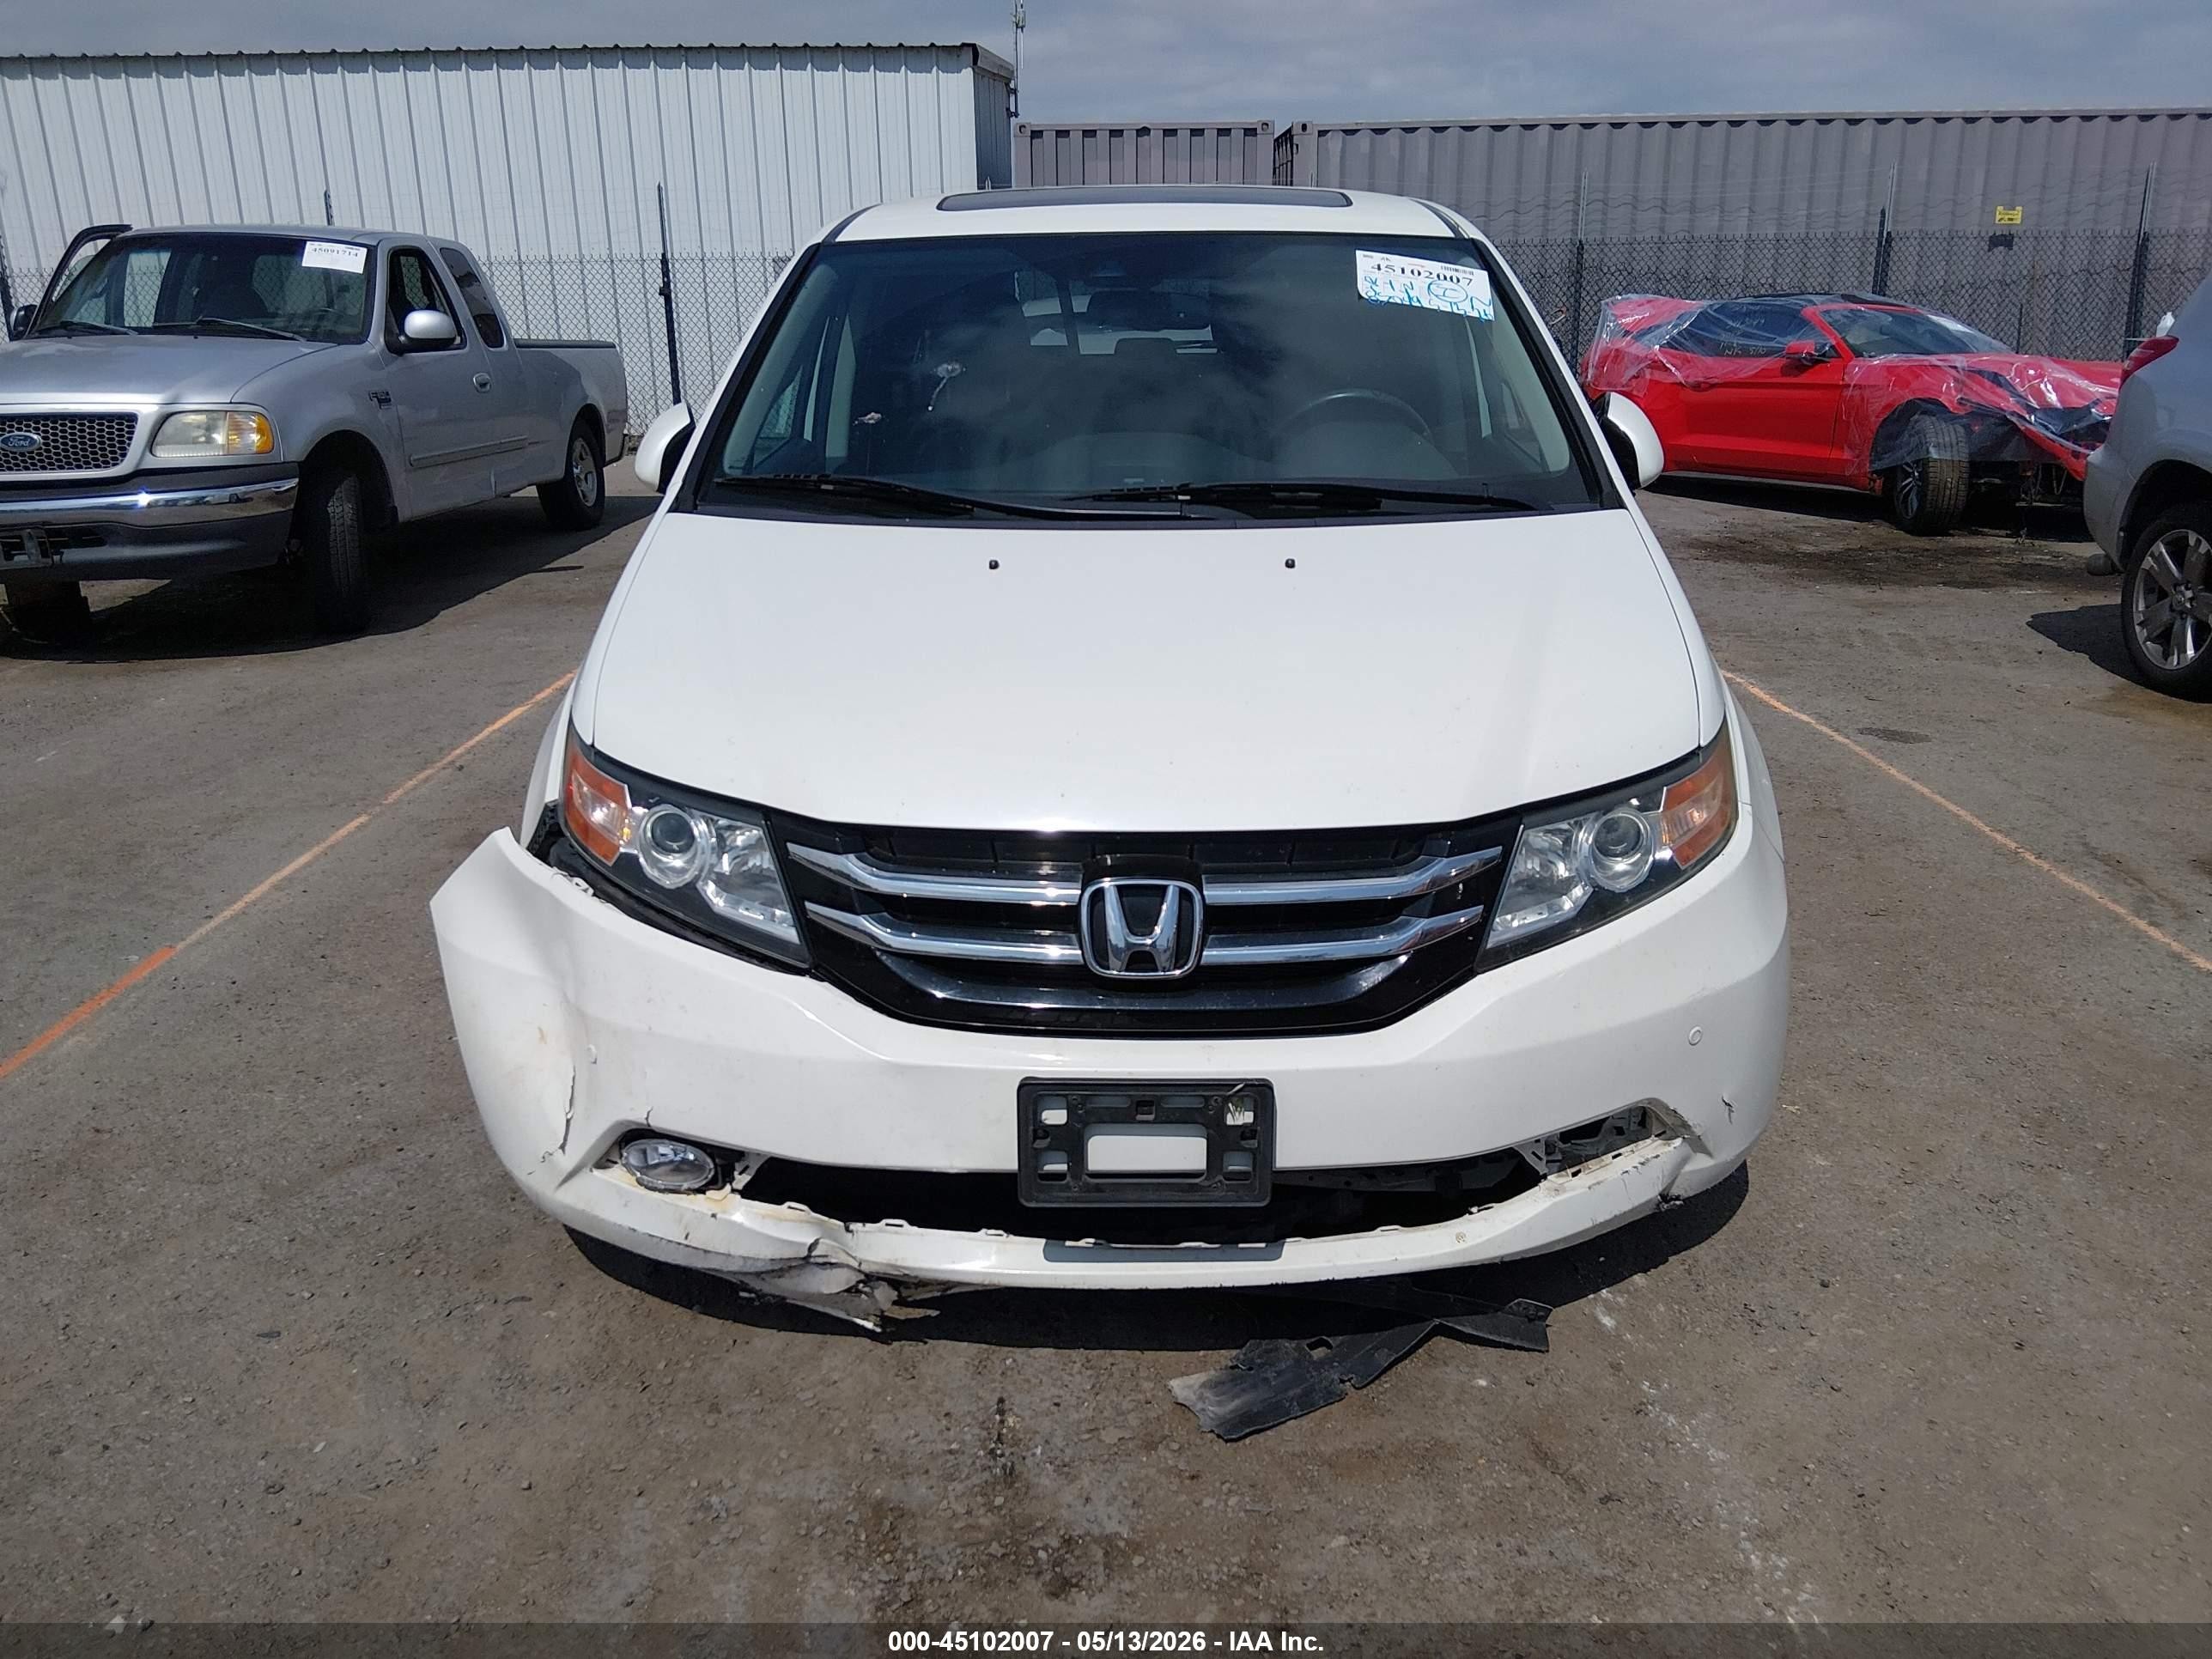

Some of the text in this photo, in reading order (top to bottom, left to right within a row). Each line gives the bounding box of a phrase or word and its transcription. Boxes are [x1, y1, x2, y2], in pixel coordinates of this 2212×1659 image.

[312, 247, 358, 257] 45091714
[1371, 264, 1474, 286] 45102007
[8, 436, 31, 447] Ford
